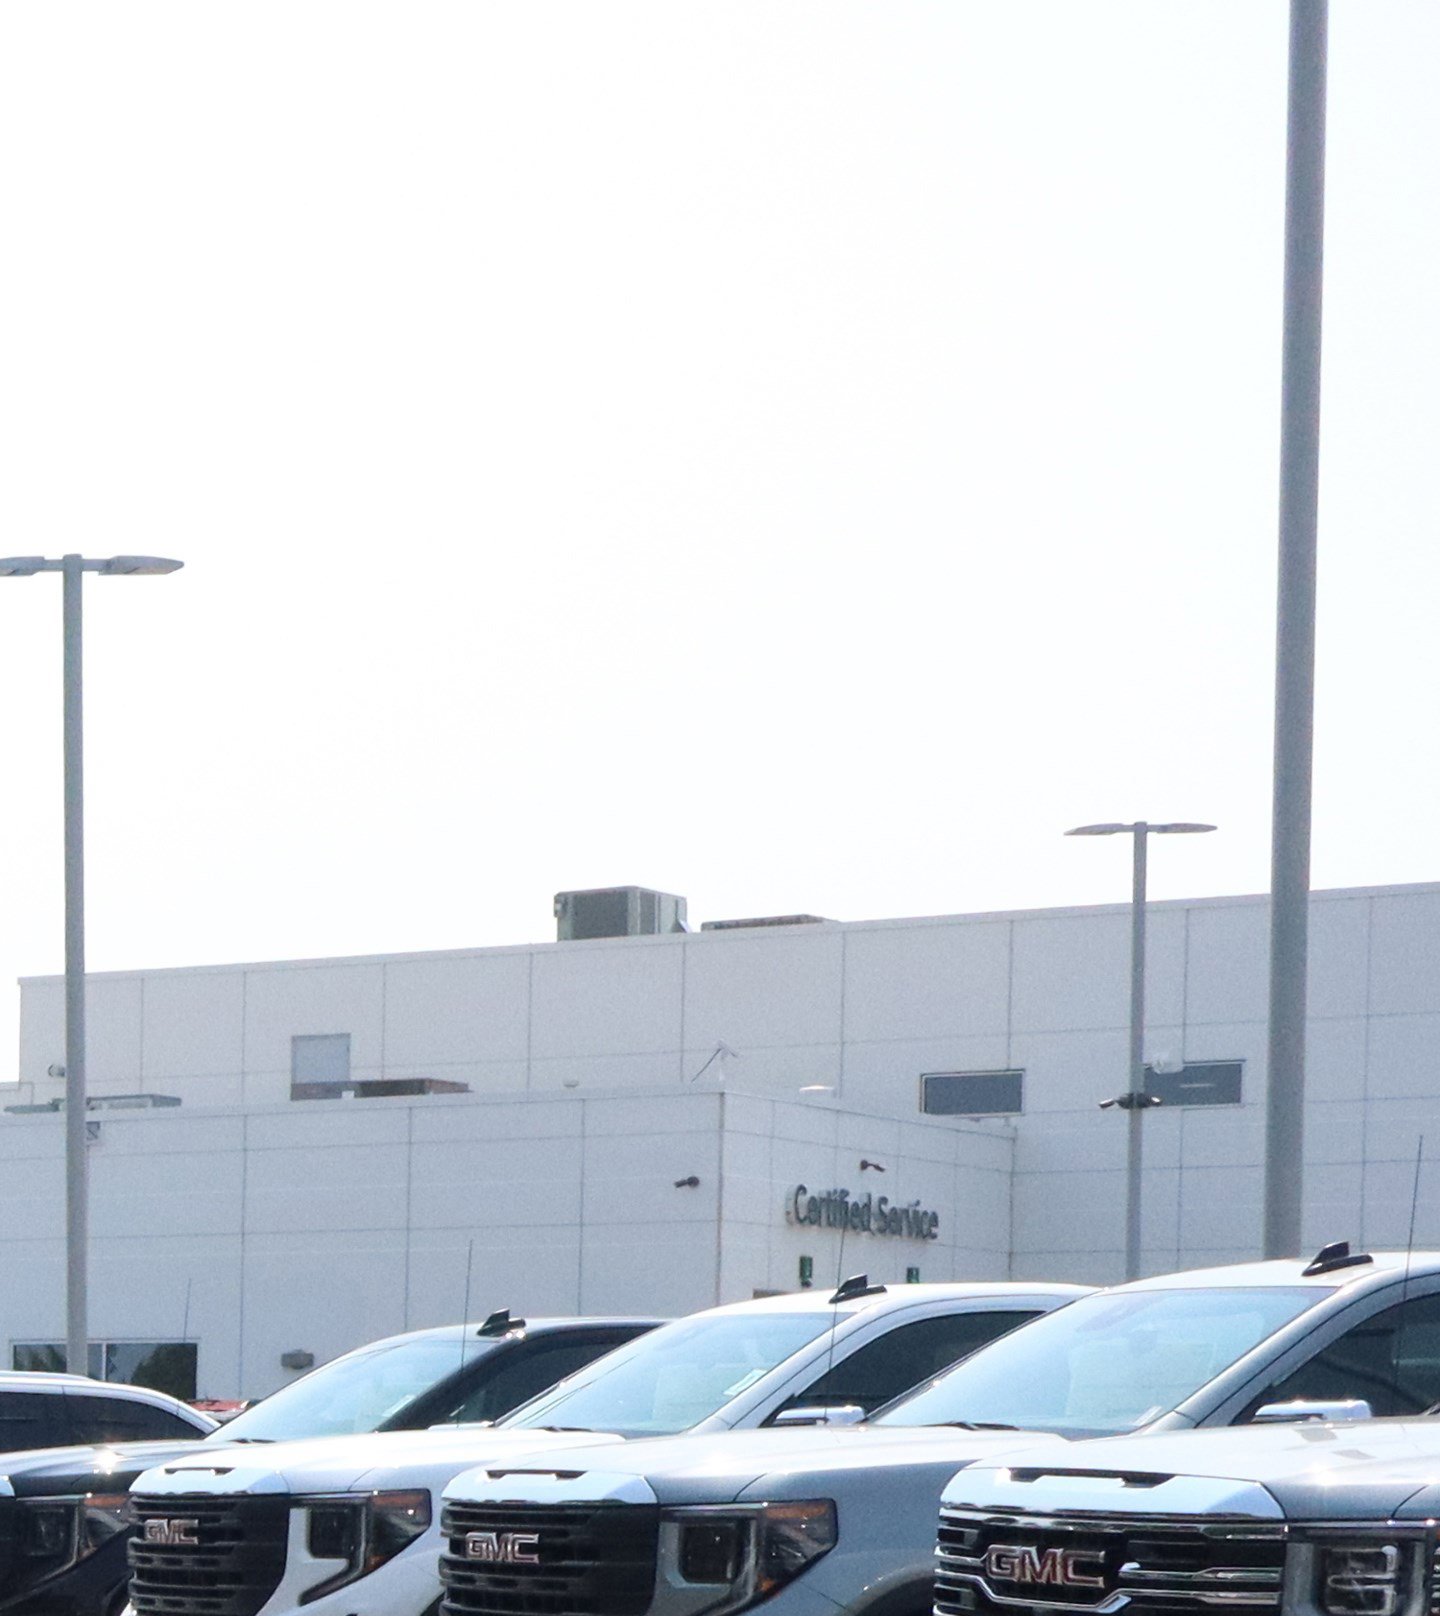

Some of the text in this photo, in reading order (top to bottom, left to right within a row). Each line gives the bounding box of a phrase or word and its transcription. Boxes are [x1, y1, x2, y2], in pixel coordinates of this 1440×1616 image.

[785, 1184, 940, 1240] Certified Service
[144, 1518, 199, 1545] GMC
[465, 1532, 540, 1564] GMC
[985, 1544, 1107, 1589] GMC
